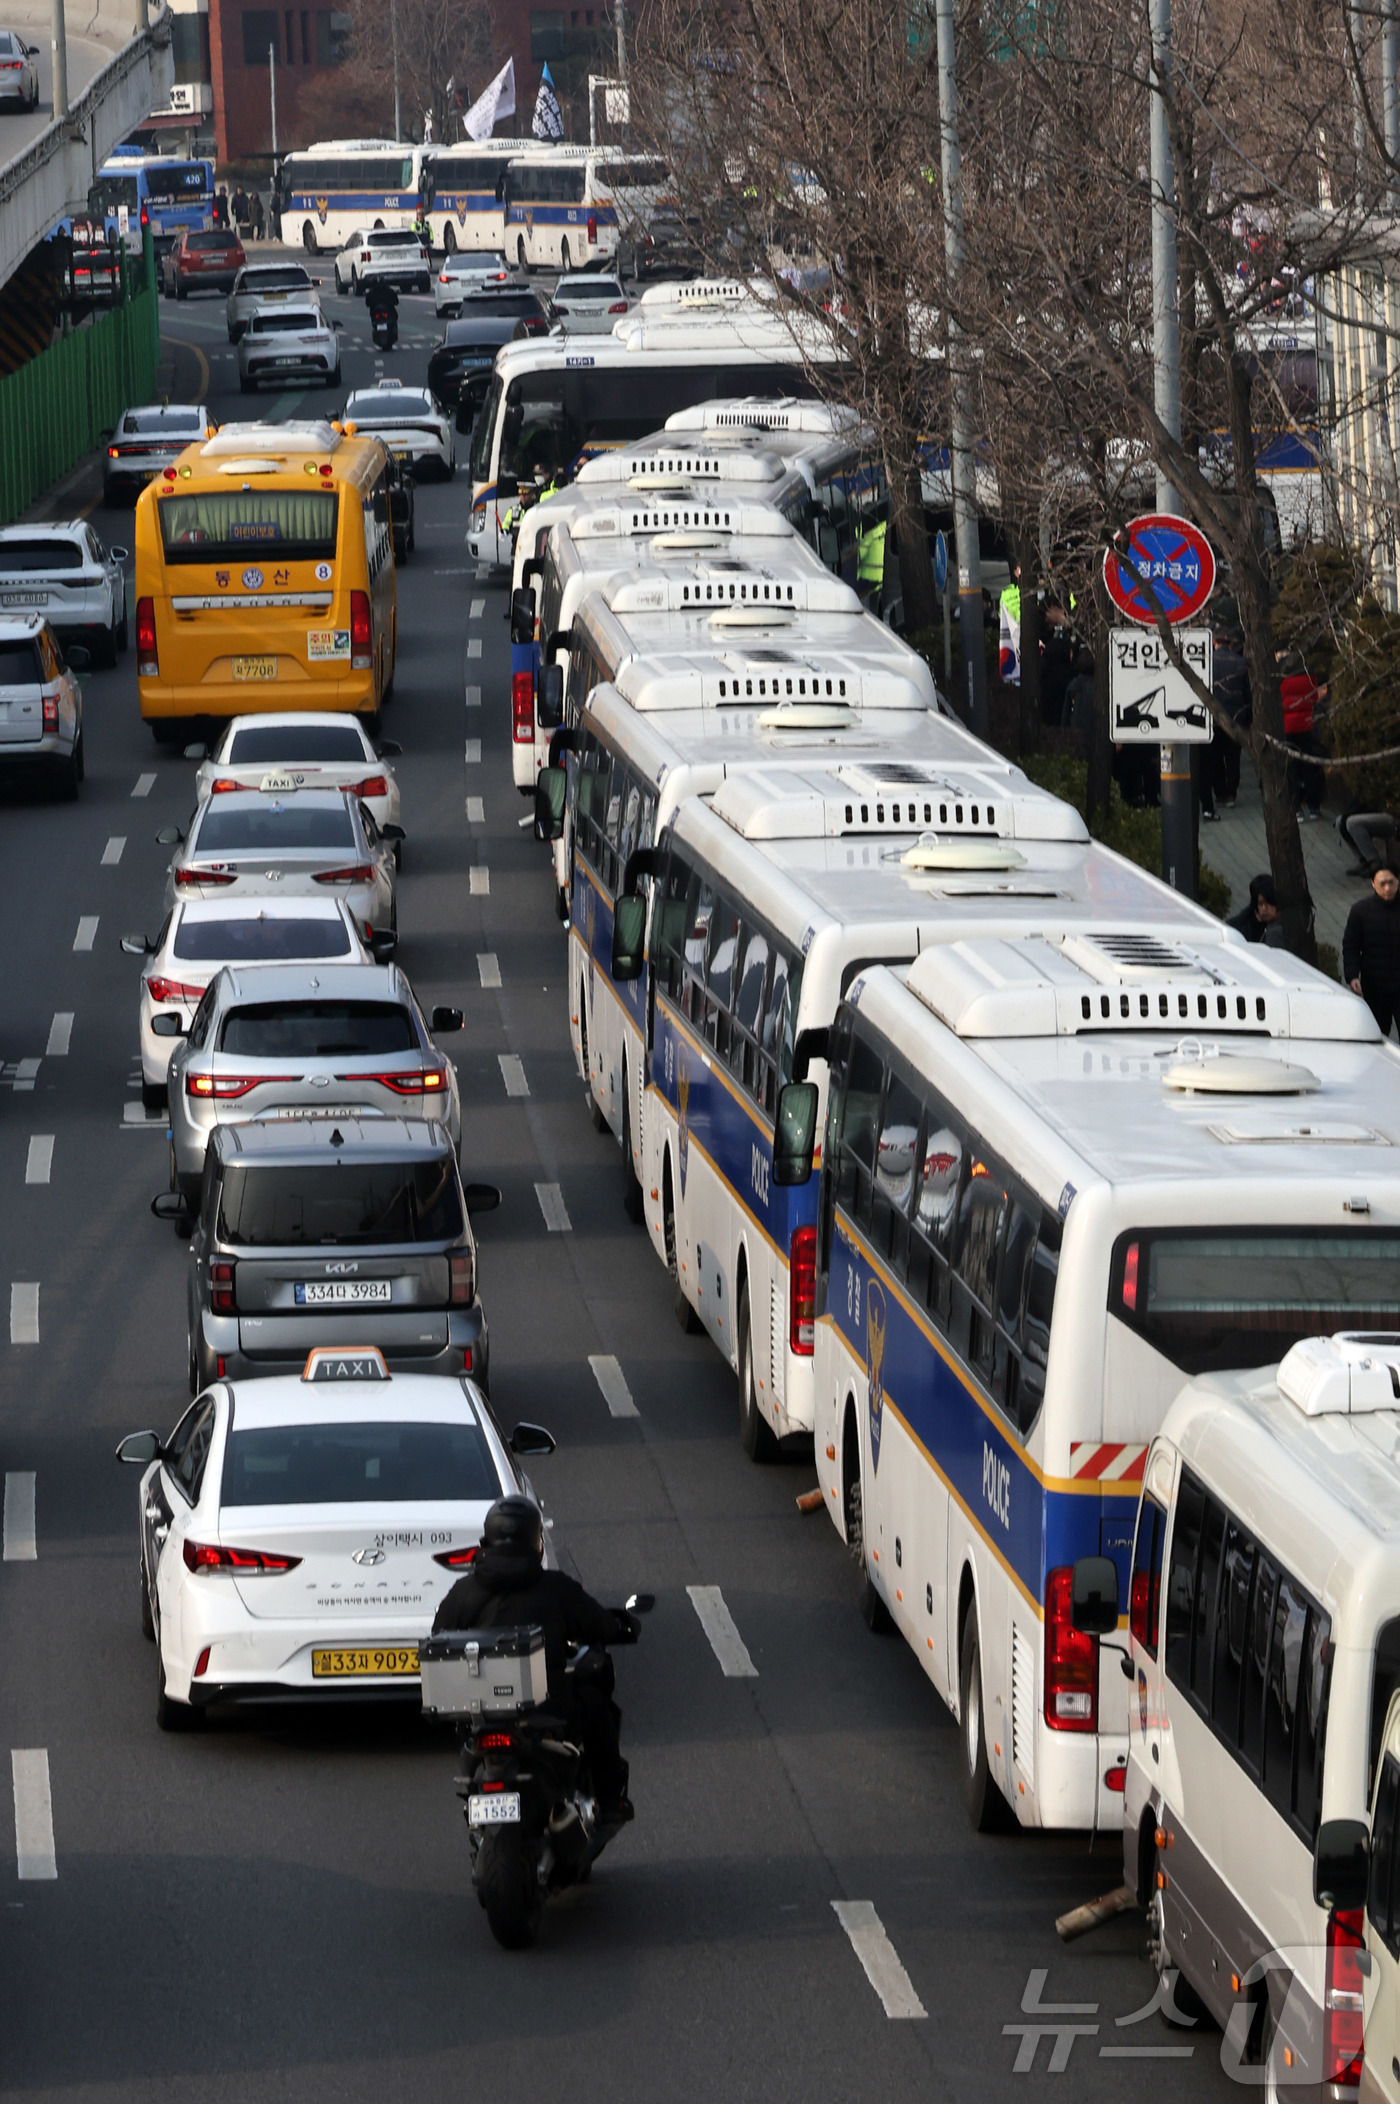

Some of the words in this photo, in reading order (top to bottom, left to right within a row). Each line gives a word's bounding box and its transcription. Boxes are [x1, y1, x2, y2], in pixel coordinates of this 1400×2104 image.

[186, 174, 200, 184] 420
[234, 525, 276, 539] 어린이보호
[273, 568, 290, 586] 산
[319, 566, 328, 579] 8
[1117, 641, 1206, 669] 견인역
[267, 780, 290, 788] TAXI
[752, 1143, 770, 1208] POLICE
[307, 1284, 346, 1300] 334다
[350, 1283, 388, 1299] 3984
[323, 1361, 373, 1377] TAXI
[983, 1440, 1010, 1531] POLICE
[431, 1532, 453, 1544] 093
[374, 1649, 421, 1669] 9093
[484, 1805, 516, 1819] 1552
